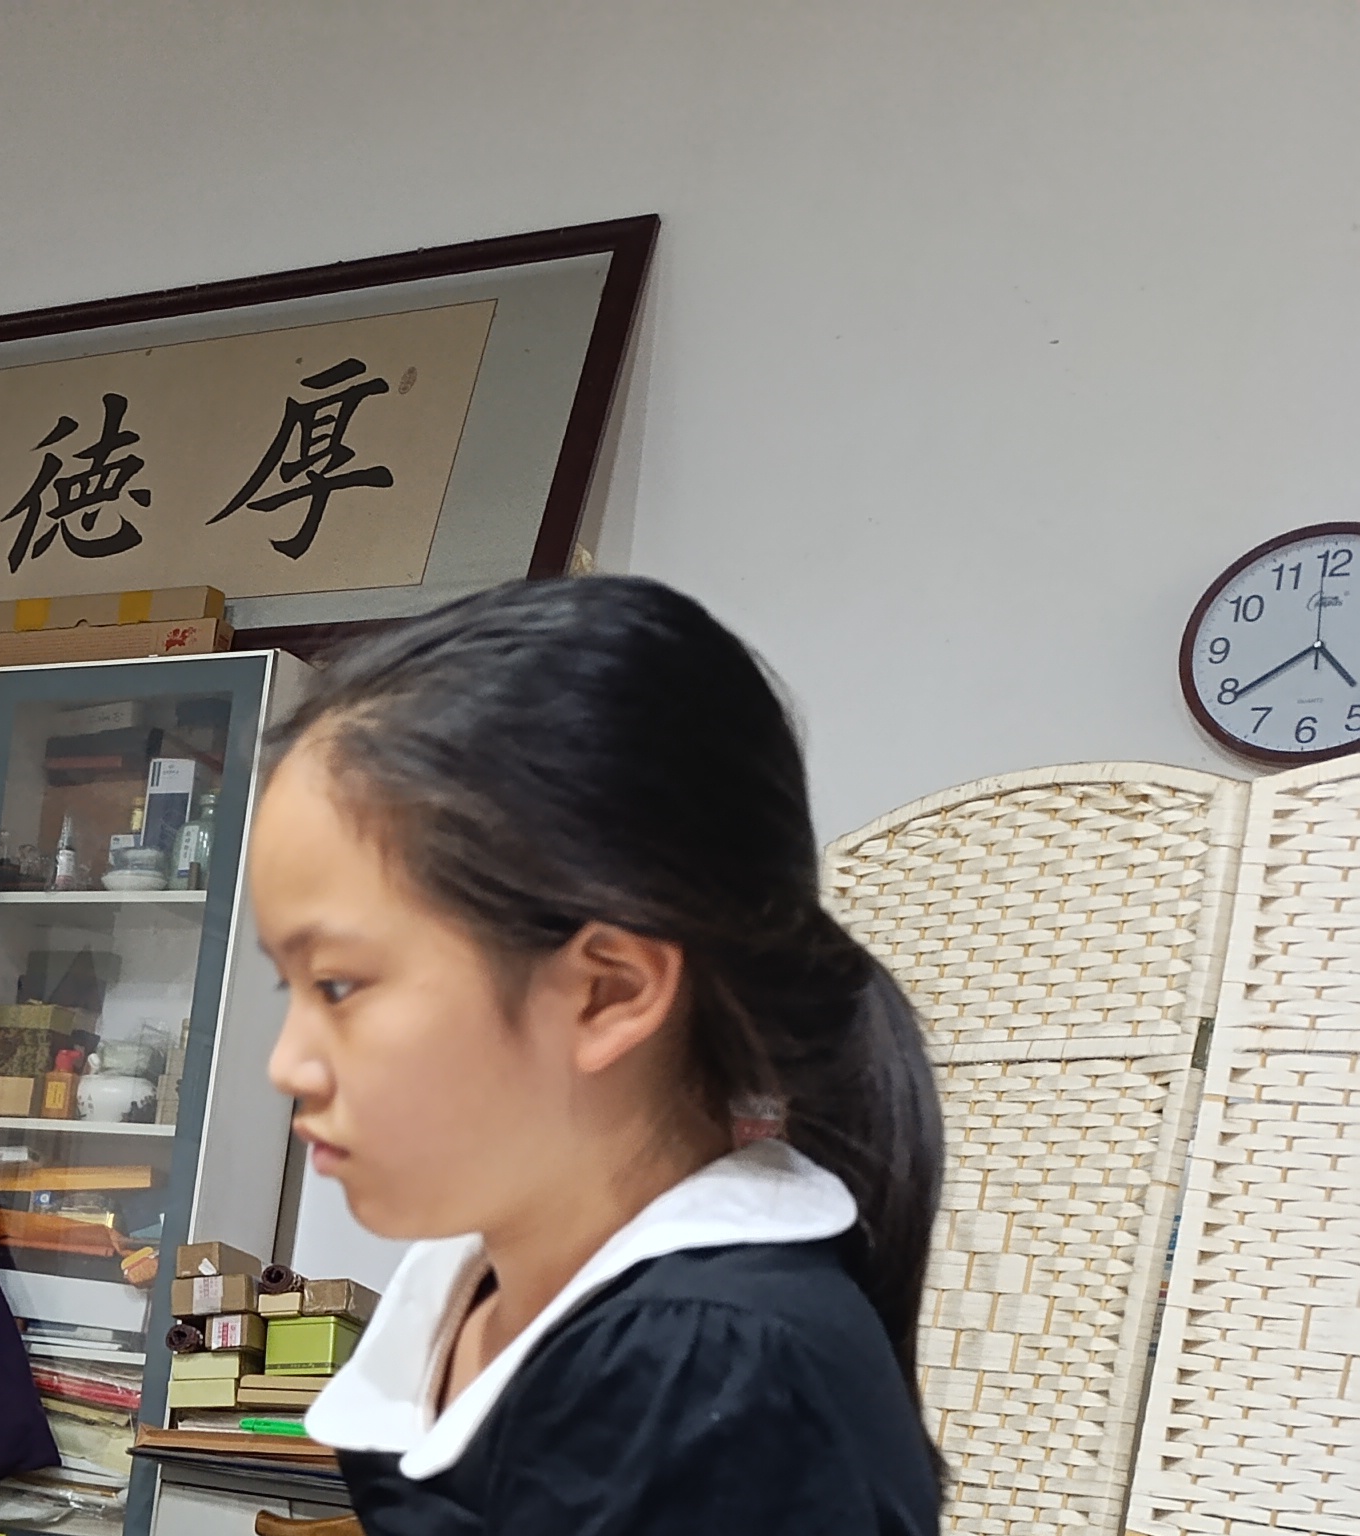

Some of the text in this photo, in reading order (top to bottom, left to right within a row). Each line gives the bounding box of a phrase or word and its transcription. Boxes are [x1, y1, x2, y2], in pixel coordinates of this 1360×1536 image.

[1272, 562, 1303, 591] 11
[1317, 549, 1353, 578] 12
[1230, 594, 1265, 623] 10
[1208, 637, 1231, 665] 9
[1217, 677, 1240, 705] 8
[1251, 706, 1273, 734] 7
[1295, 716, 1318, 744] 6
